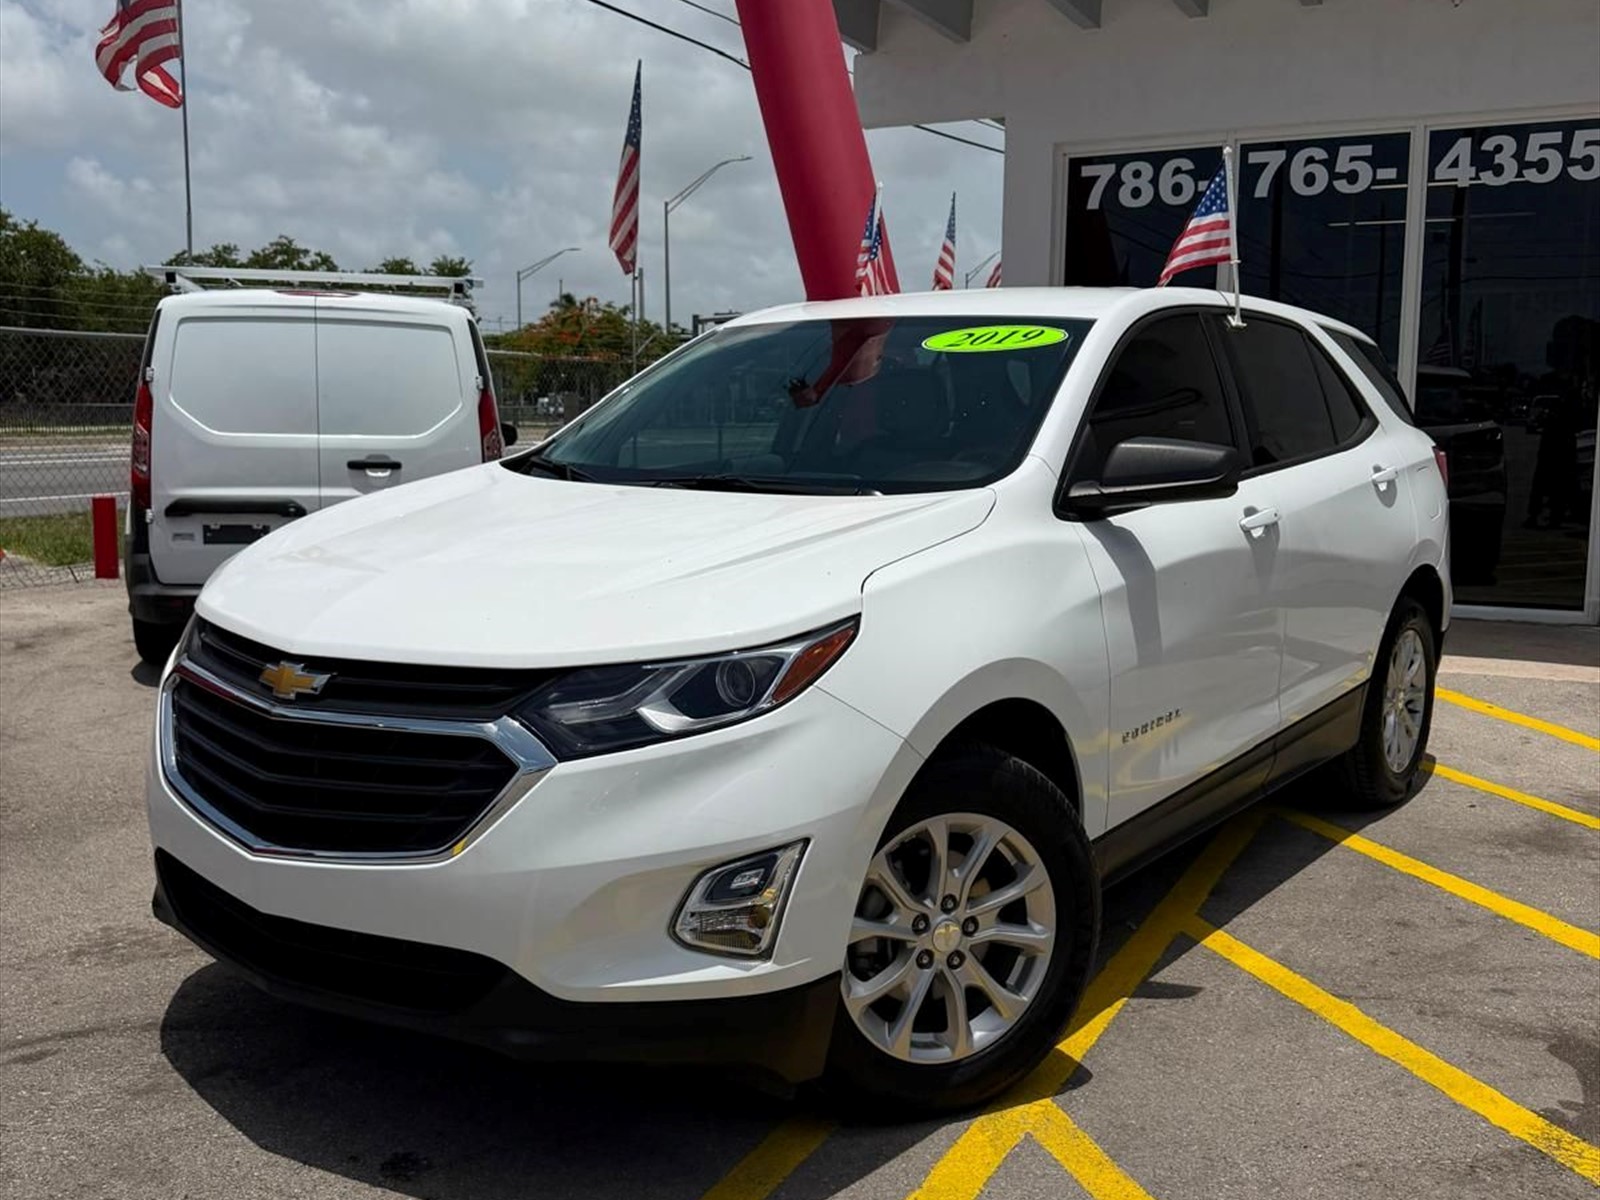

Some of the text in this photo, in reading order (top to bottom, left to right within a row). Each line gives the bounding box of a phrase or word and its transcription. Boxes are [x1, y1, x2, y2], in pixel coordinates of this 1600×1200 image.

[1247, 144, 1397, 198] 765-
[1434, 128, 1600, 188] 4355
[944, 328, 1046, 348] 2019
